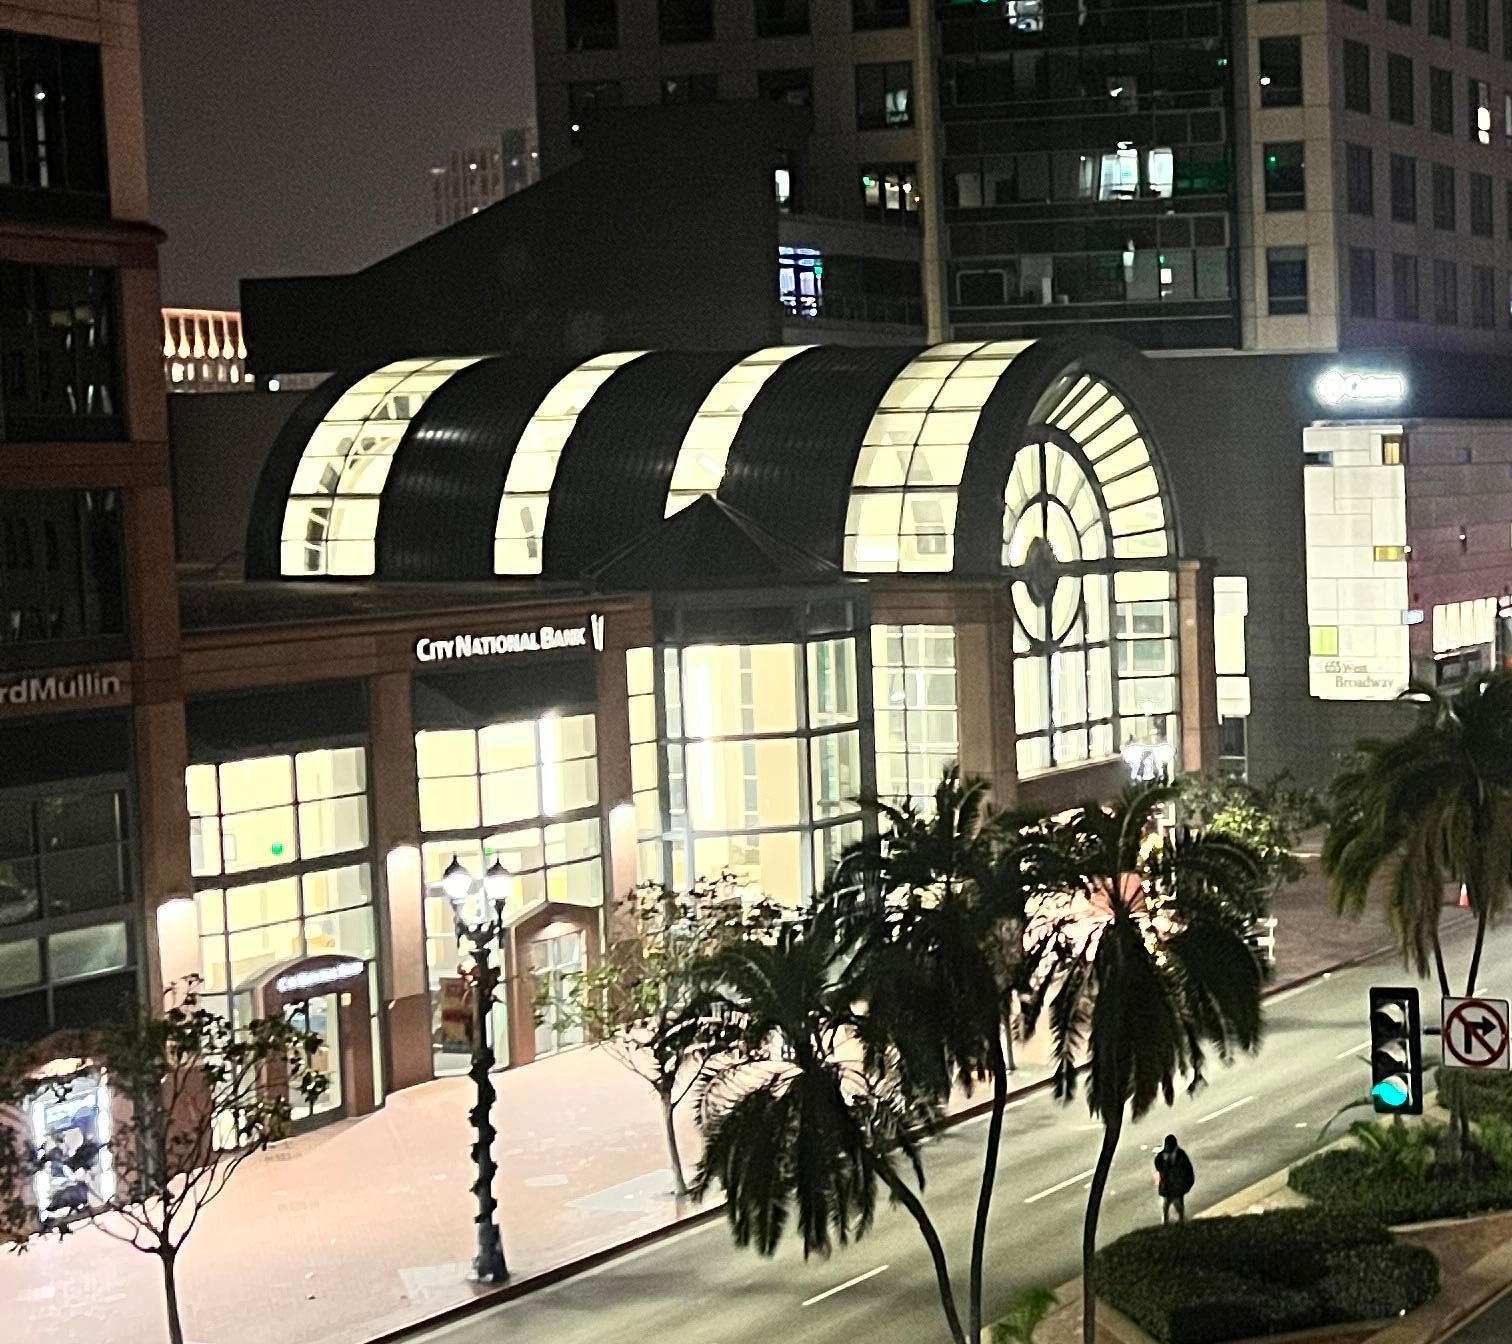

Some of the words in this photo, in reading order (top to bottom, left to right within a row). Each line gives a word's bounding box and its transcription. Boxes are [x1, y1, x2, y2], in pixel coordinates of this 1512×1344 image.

[416, 638, 455, 662] CITY
[455, 632, 541, 658] NATIONAL
[540, 626, 586, 650] BANK
[1336, 675, 1394, 688] Broadway
